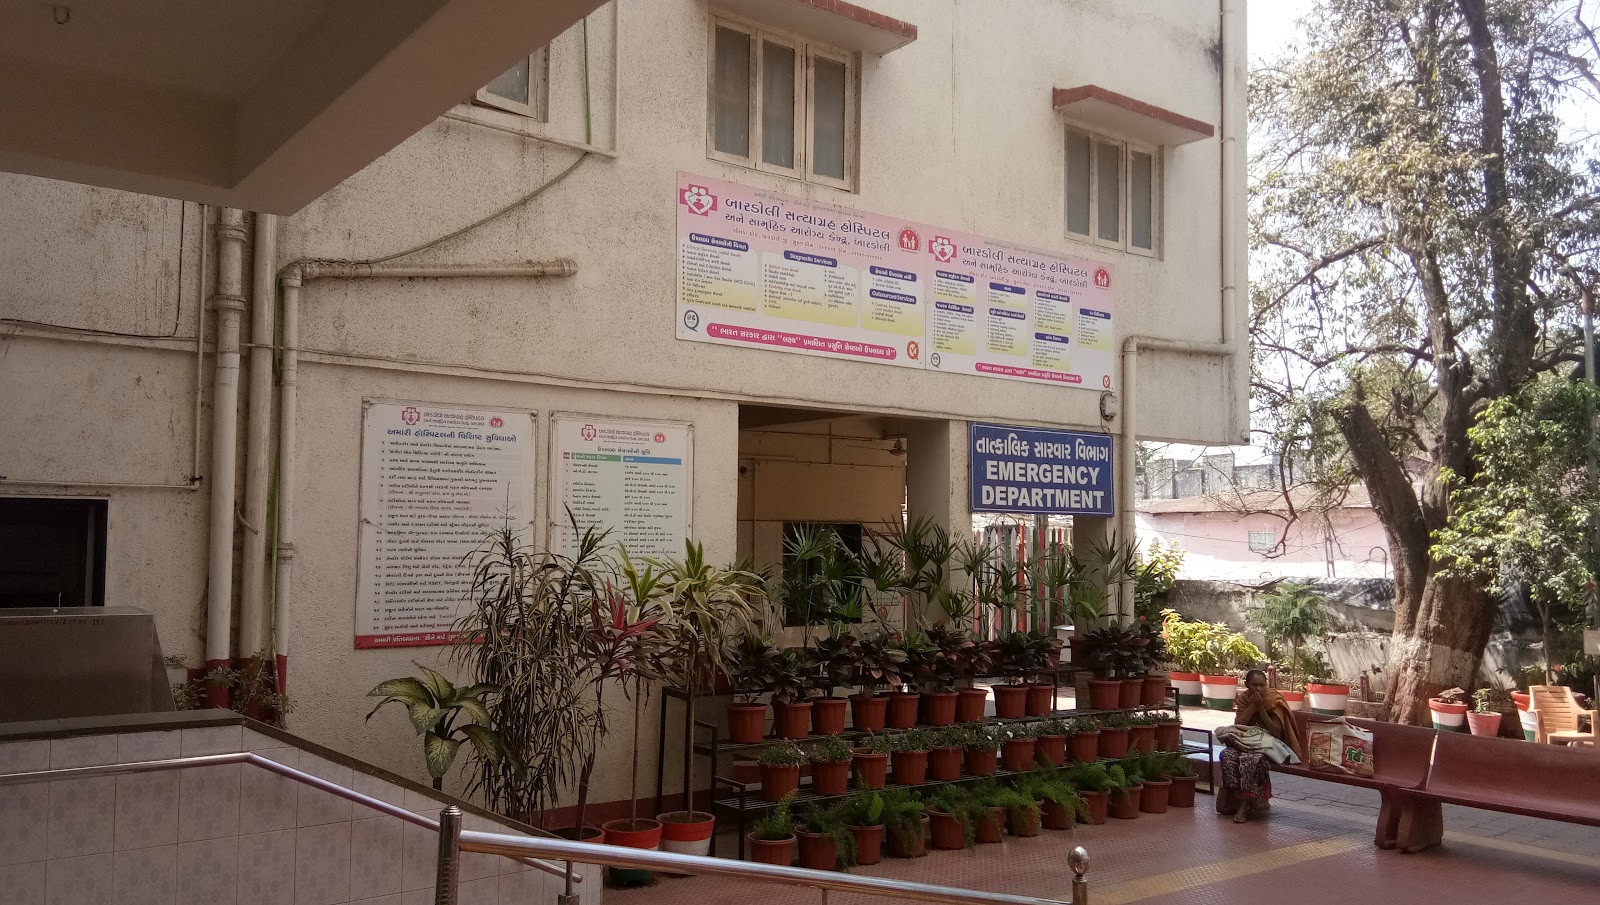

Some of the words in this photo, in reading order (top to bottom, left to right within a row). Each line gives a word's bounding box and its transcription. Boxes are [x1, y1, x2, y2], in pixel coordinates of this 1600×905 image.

[725, 212, 744, 224] અને
[854, 238, 890, 252] બારડોલી
[726, 198, 780, 218] બારડોલી
[785, 211, 836, 231] સત્યાગ્રહ
[841, 220, 890, 240] હોસ્પિટલ
[790, 253, 813, 262] Diagnostic
[814, 257, 832, 266] Services
[962, 245, 1003, 261] બારડોલી
[1008, 255, 1046, 270] સત્યાગ્રહ
[1049, 262, 1088, 278] હોસ્પિટલ
[962, 259, 976, 268] અને
[1060, 277, 1088, 288] બારડોલી
[740, 330, 760, 339] સરકાર
[415, 430, 455, 439] હોસ્પિટલની
[458, 432, 482, 440] વિશિષ્ટ
[486, 434, 516, 443] સુવિધાઓ
[976, 433, 1029, 457] તાત્કાલિક
[1034, 441, 1071, 459] સારવાર
[1076, 438, 1108, 462] વિભાગ
[986, 460, 1100, 485] EMERGENCY
[982, 485, 1104, 509] DEPARTMENT
